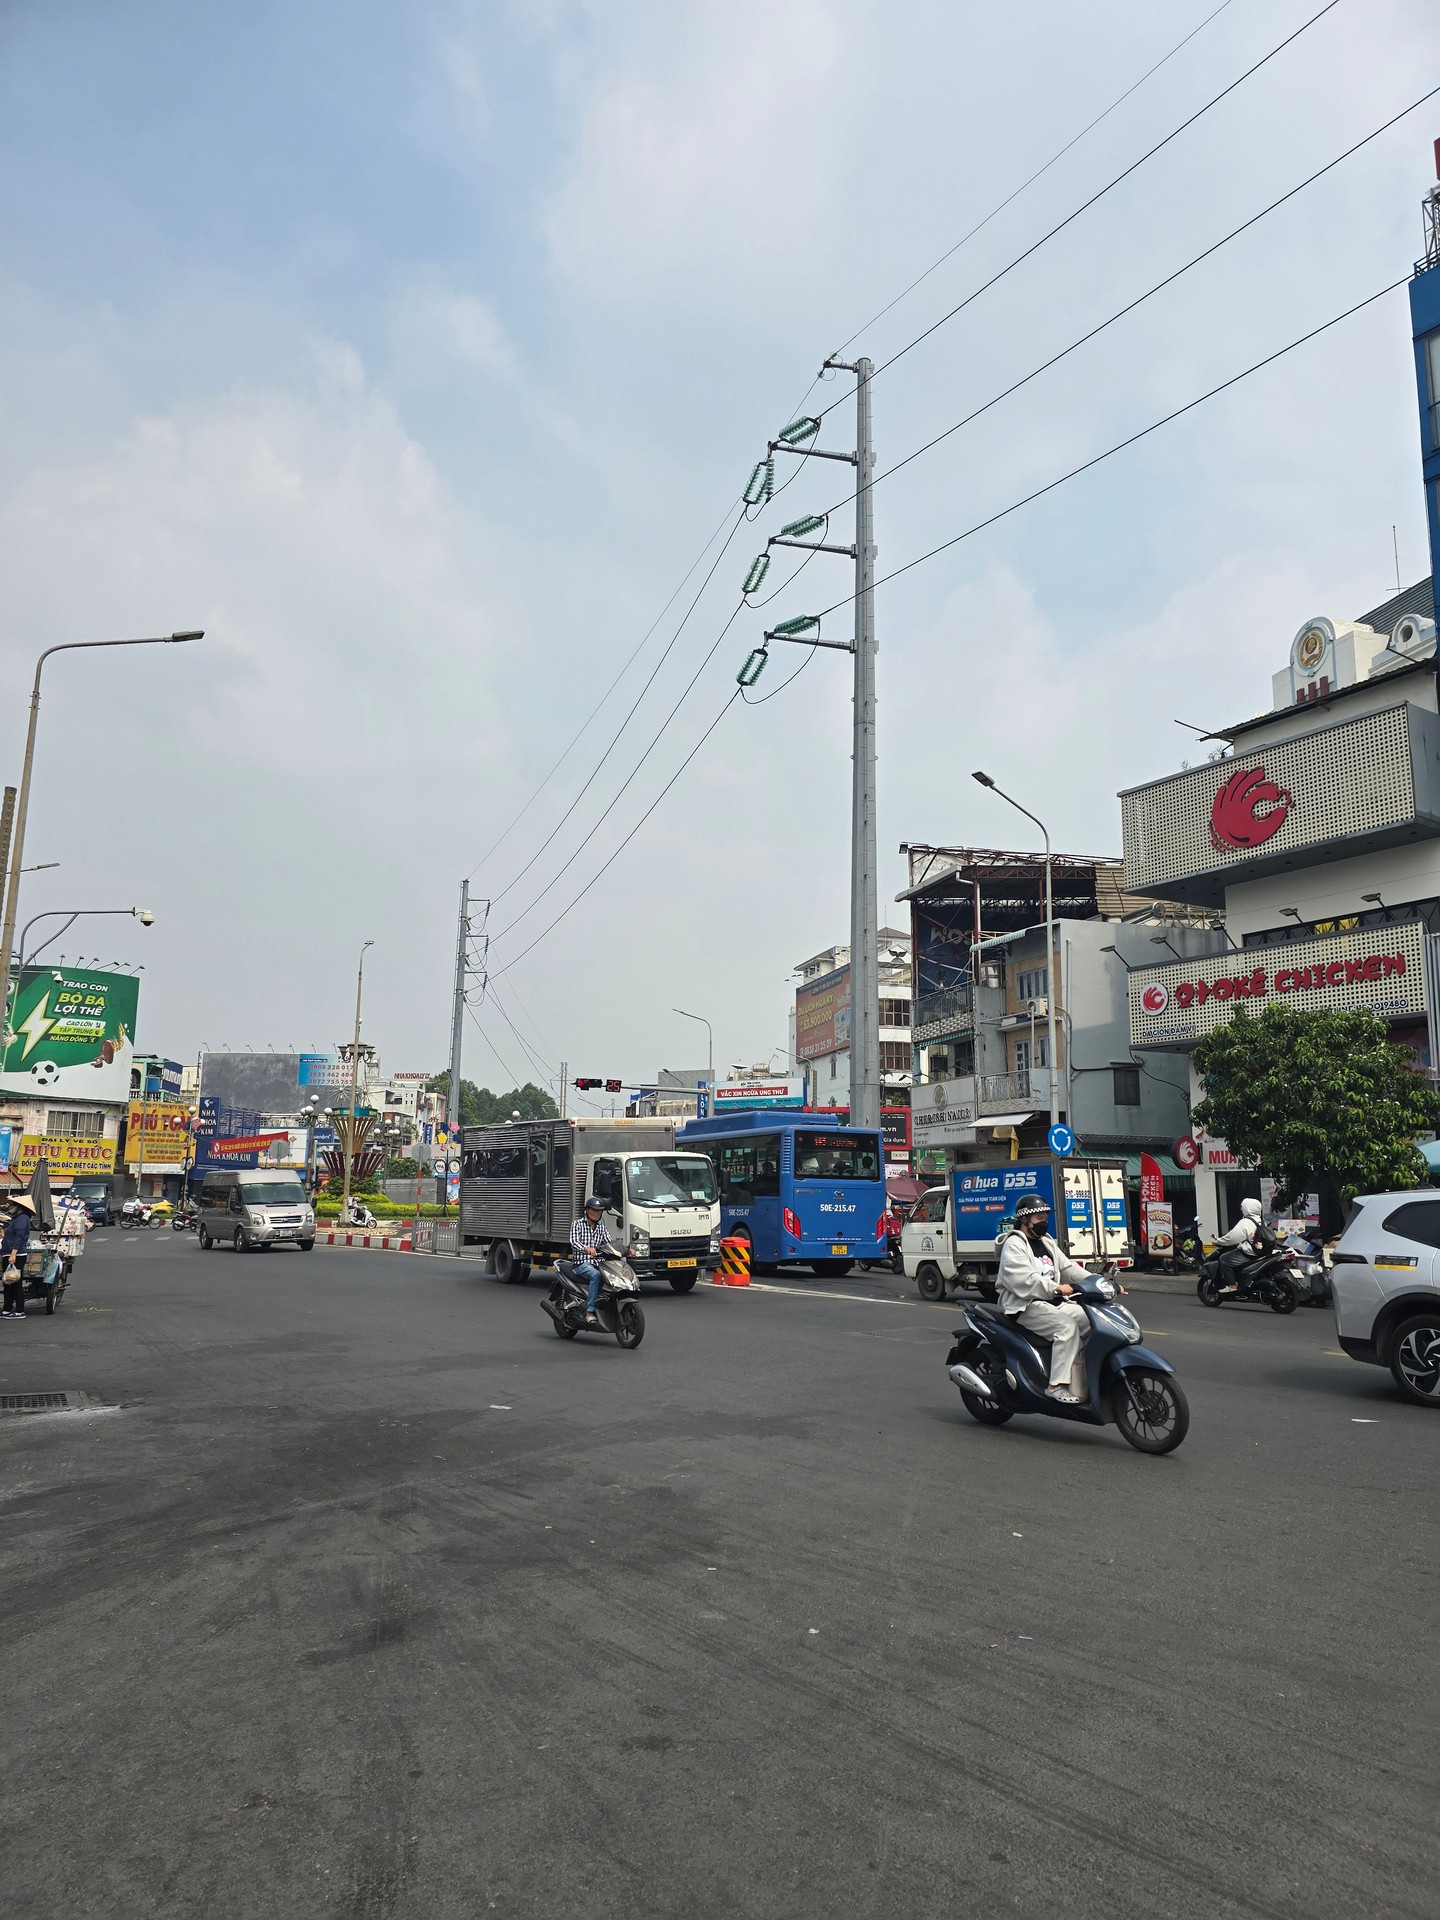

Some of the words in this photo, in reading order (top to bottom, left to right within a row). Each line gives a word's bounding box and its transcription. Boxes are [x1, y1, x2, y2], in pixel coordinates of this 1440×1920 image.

[1275, 952, 1406, 993] CHICKEN
[62, 980, 88, 990] TRAO
[89, 984, 109, 992] CON
[84, 995, 105, 1006] BA
[1383, 999, 1408, 1009] 9480
[54, 1004, 78, 1015] LỢI
[79, 1005, 106, 1016] THẾ
[607, 1081, 620, 1092] 25
[201, 1109, 216, 1117] NHA
[131, 1109, 159, 1131] PHÚ
[23, 1143, 62, 1158] HỮU
[66, 1145, 113, 1160] THỨC
[221, 1152, 239, 1162] KHOA
[239, 1153, 251, 1162] KIM
[1208, 1150, 1238, 1165] MUA
[1004, 1171, 1037, 1187] DSS
[819, 1204, 857, 1213] 50E-215.47
[1071, 1201, 1086, 1209] DSS
[1106, 1201, 1121, 1209] DSS
